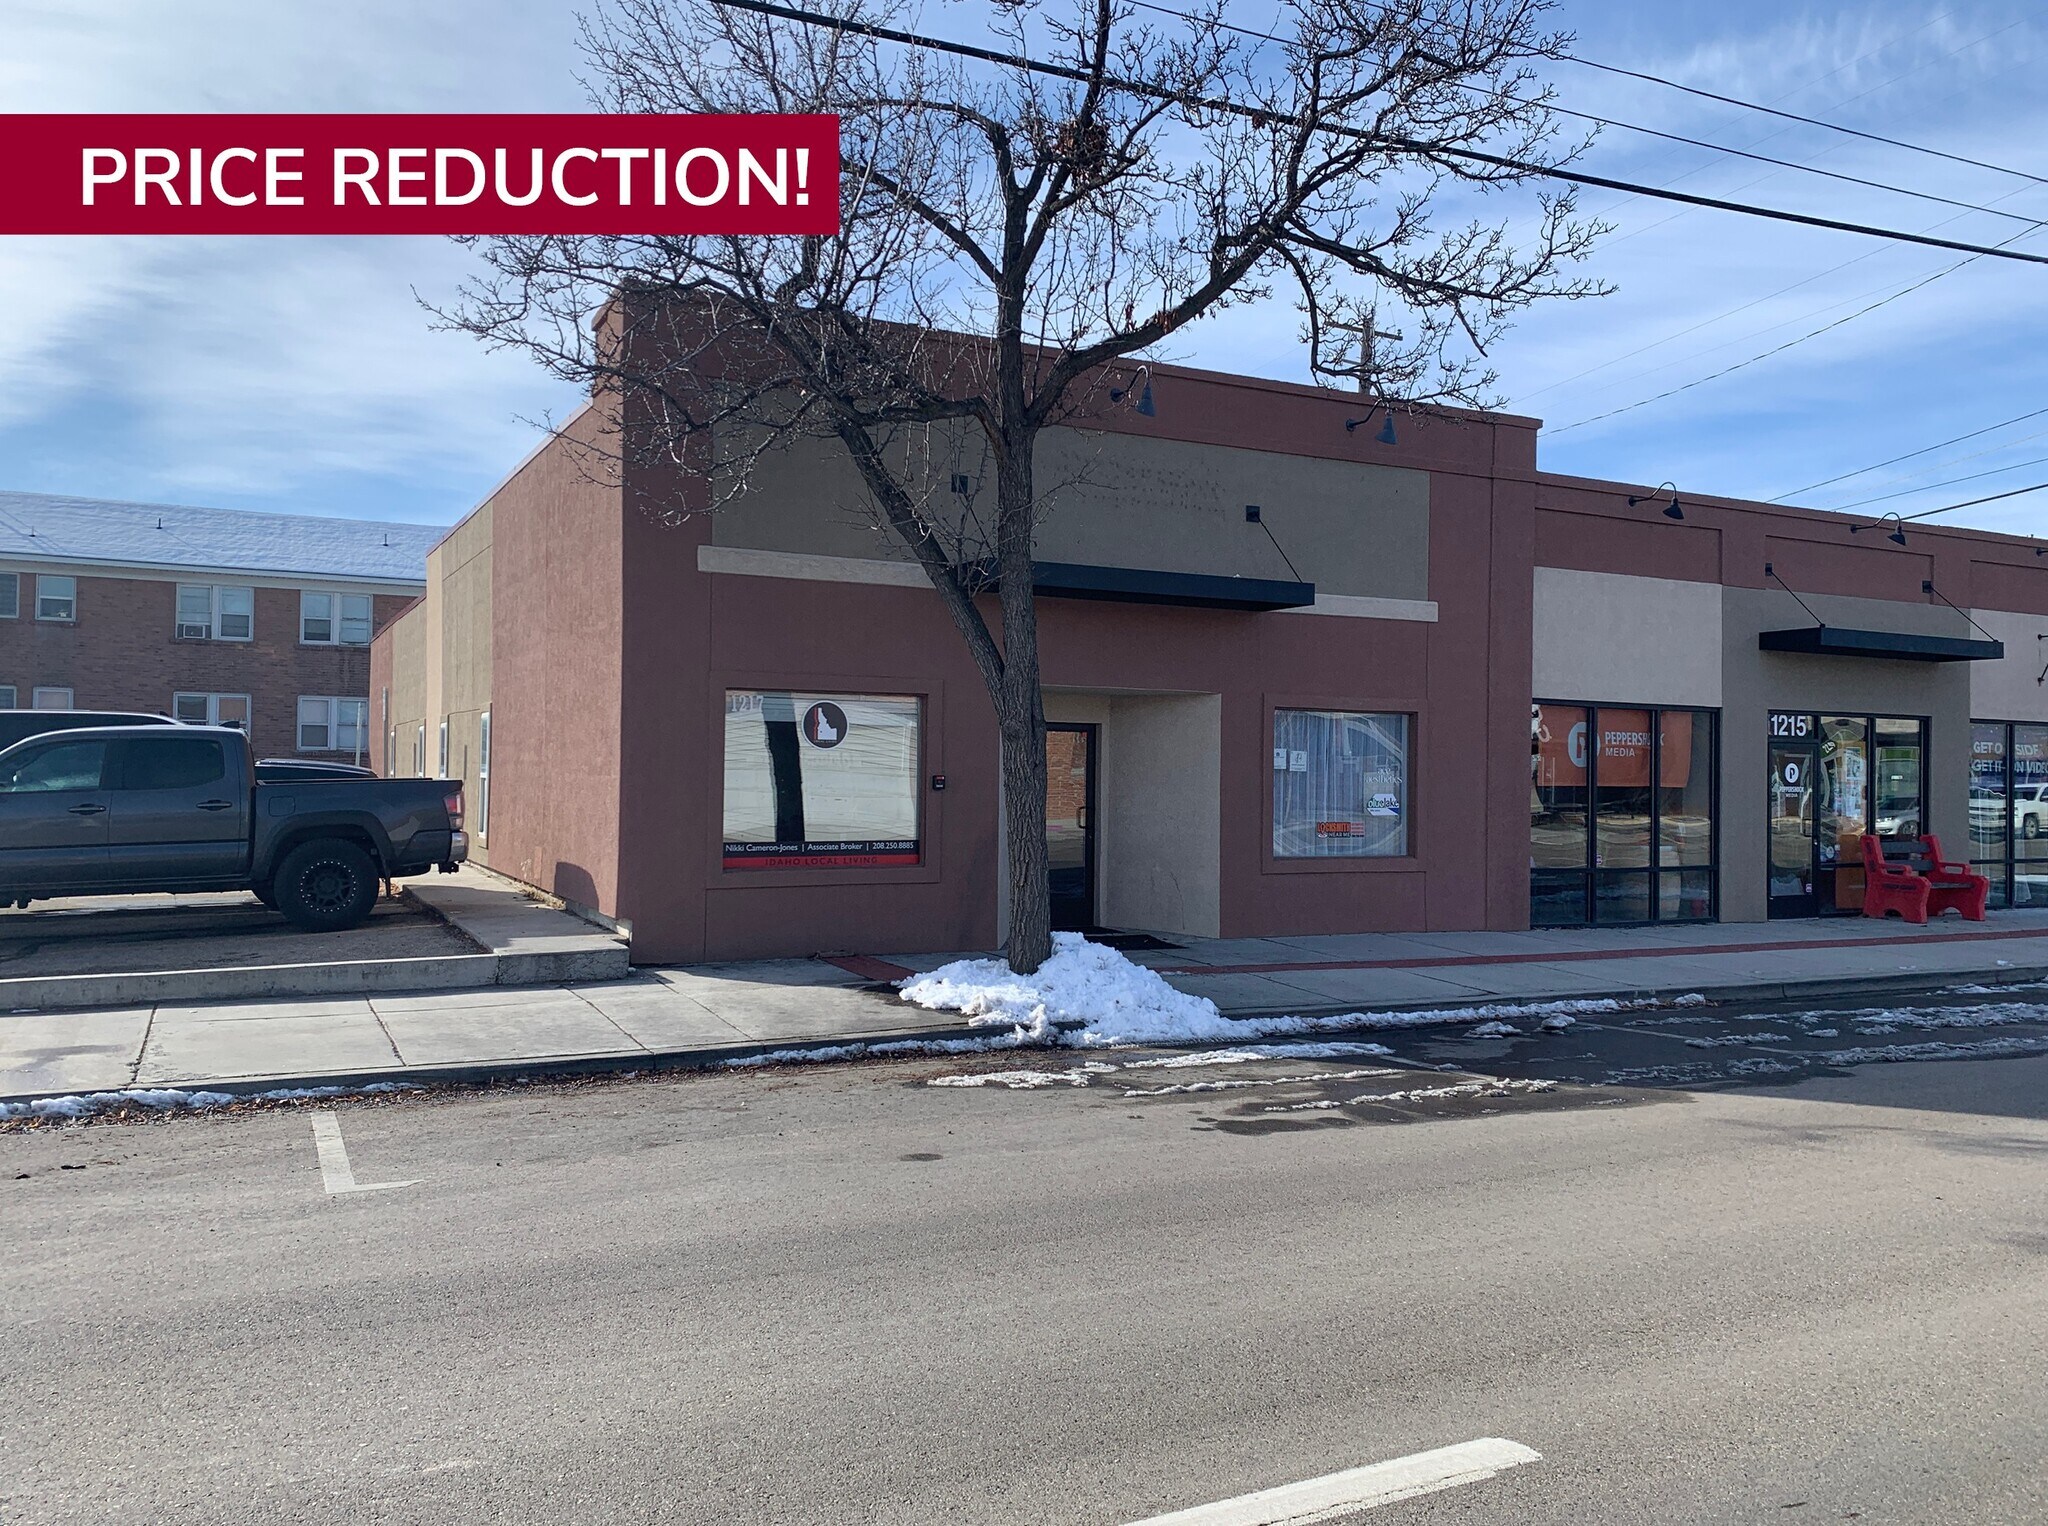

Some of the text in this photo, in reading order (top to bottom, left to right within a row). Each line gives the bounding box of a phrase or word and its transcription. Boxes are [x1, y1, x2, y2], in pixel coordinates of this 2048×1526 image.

[731, 694, 763, 711] 1217
[1771, 714, 1807, 736] 1215
[1605, 731, 1665, 745] PEPPERSHOK
[1605, 747, 1635, 757] MEDIA
[1973, 741, 2039, 756] GET OSIDE
[1972, 759, 1993, 772] GET
[1994, 760, 2003, 773] IT
[725, 844, 744, 852] Nikki
[746, 843, 798, 853] Cameron-Jones
[807, 843, 839, 851] Associate
[840, 842, 863, 850] Broker
[765, 856, 878, 866] IDAHO LOCAL LIVING
